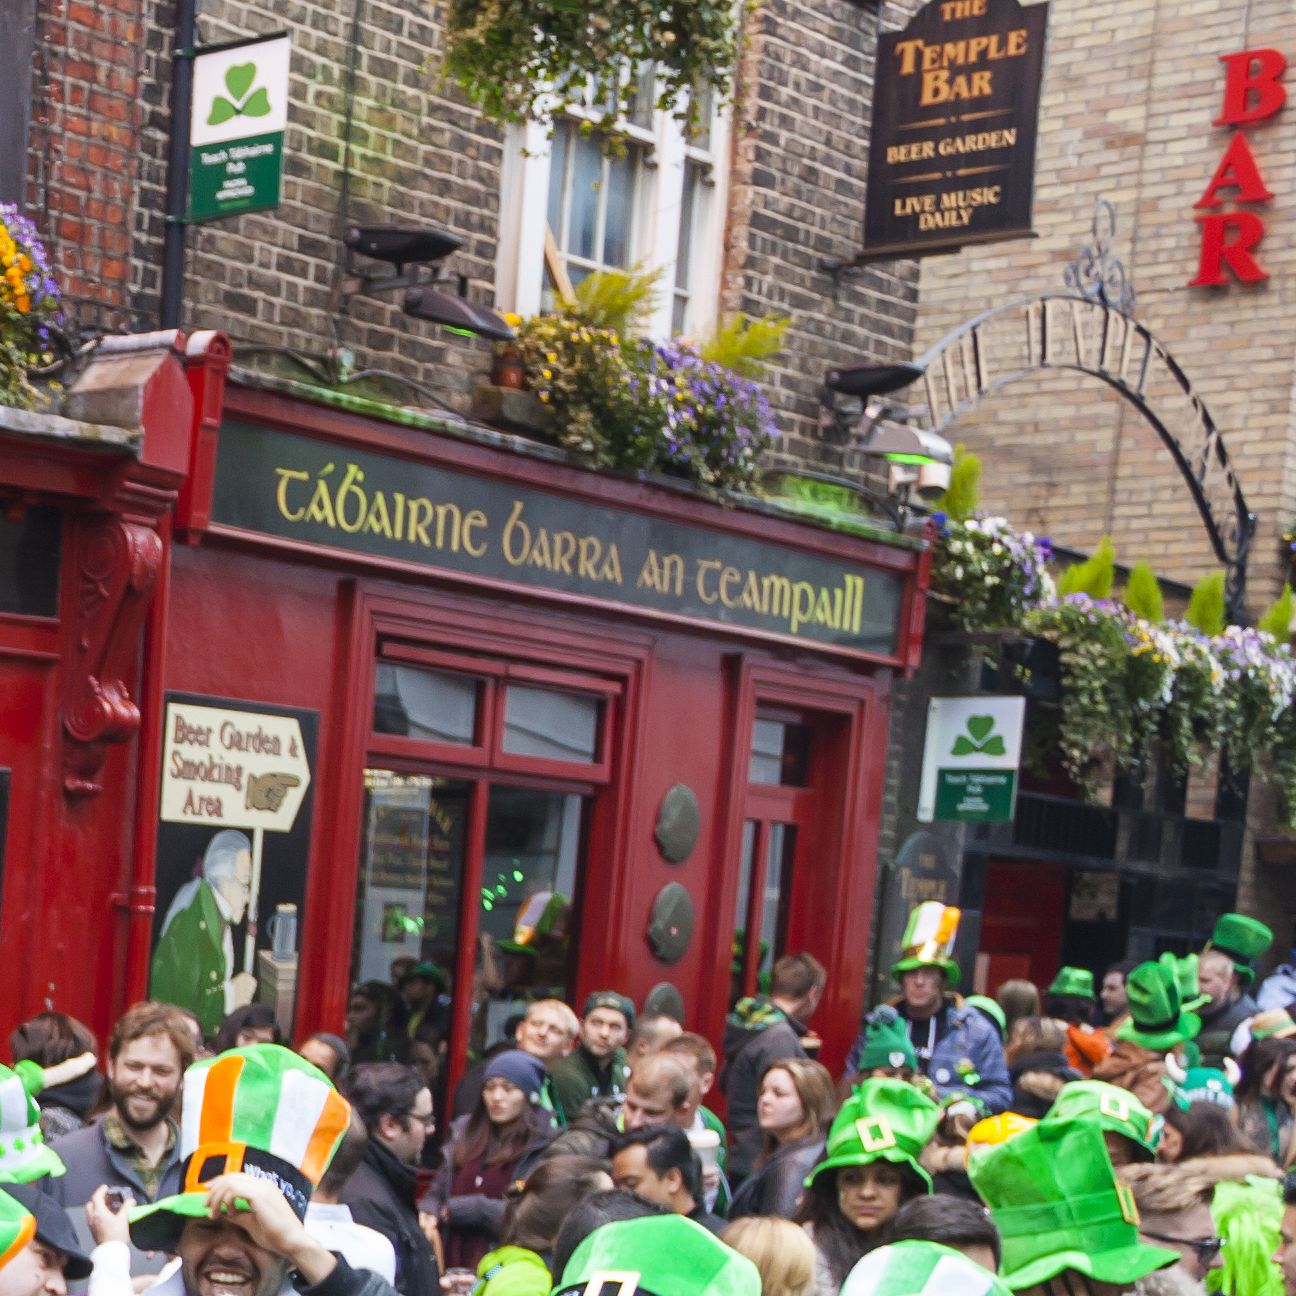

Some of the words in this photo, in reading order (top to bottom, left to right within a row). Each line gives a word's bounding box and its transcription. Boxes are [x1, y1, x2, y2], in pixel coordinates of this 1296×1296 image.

[940, 0, 987, 21] THE
[895, 29, 1028, 75] TEMPLE
[919, 69, 993, 107] BAR
[887, 140, 934, 164] BEER
[938, 128, 1017, 157] GARDEN
[1187, 48, 1287, 287] BAR
[894, 194, 936, 217] LIVE
[940, 185, 1002, 209] MUSIC
[919, 207, 973, 231] DAILY
[173, 713, 213, 748] Beer
[219, 719, 282, 757] Garden
[170, 750, 243, 792] Smoking
[182, 787, 224, 818] Area
